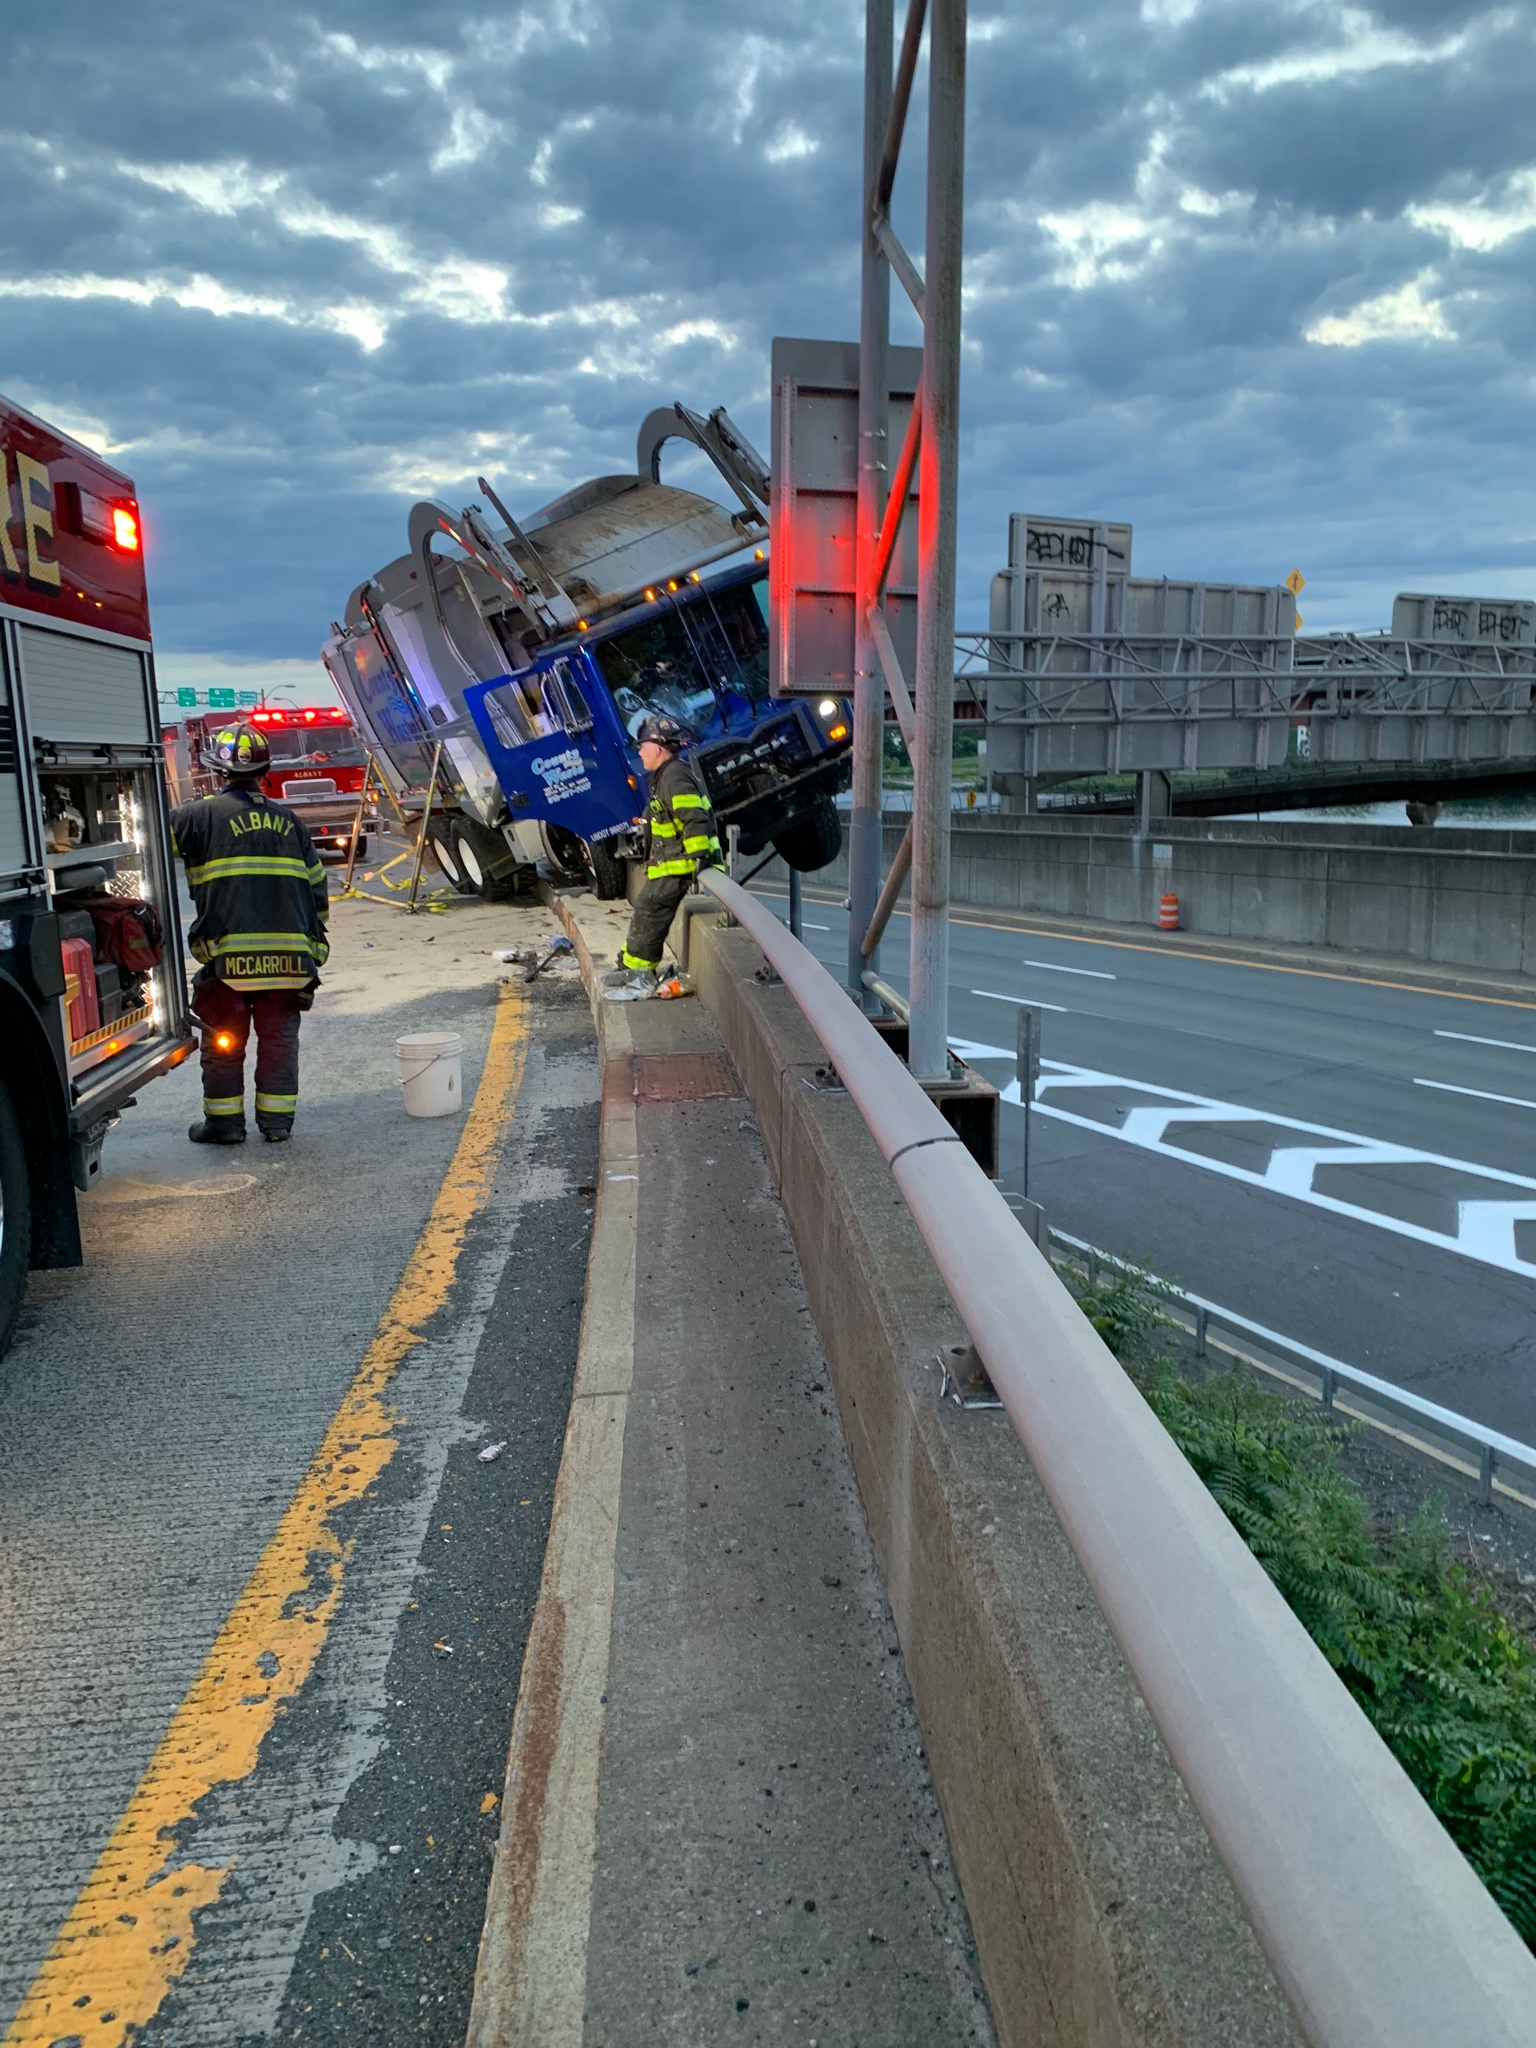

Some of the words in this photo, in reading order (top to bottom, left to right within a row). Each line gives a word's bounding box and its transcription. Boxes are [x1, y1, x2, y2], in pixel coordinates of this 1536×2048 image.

[531, 748, 580, 775] County
[715, 735, 789, 775] MACK
[293, 771, 323, 779] ALBANY
[541, 764, 585, 787] Waste
[229, 811, 294, 838] ALBANY
[320, 826, 329, 836] 9
[225, 955, 308, 977] MCCARROLL
